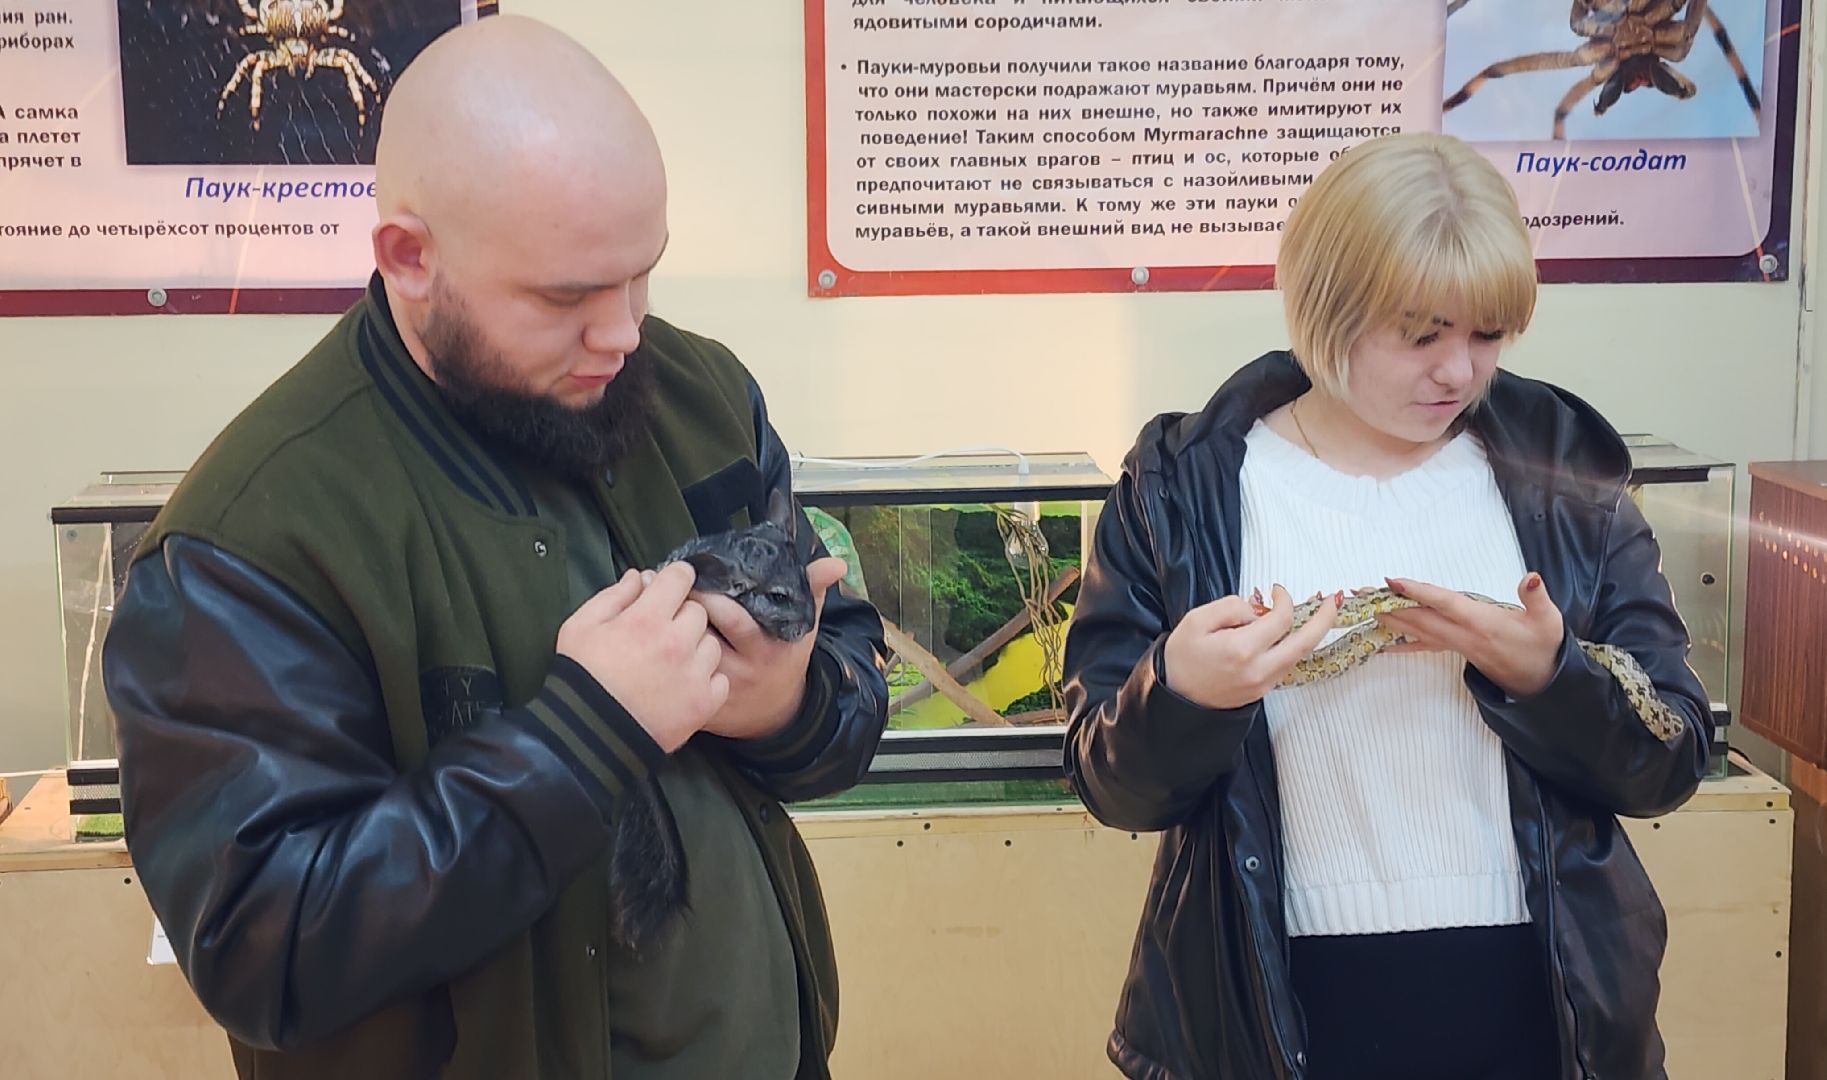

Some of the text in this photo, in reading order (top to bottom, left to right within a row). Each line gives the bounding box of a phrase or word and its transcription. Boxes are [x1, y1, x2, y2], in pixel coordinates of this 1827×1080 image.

[34, 11, 73, 29] ран.
[853, 15, 1103, 33] ядовитыми сородичами.
[857, 53, 1405, 78] Пауки-муровьи получили такое название благодаря тому,
[858, 76, 1404, 101] что они мастерски подражают муравьям. Причём они не
[14, 107, 79, 120] самка
[854, 102, 1402, 122] только похожи на них внешне, но также имитируют их
[16, 131, 81, 145] плетет
[860, 124, 1401, 148] поведение! Таким способом Myrmarachne защищаются
[70, 156, 82, 168] в
[856, 156, 877, 169] от
[884, 156, 941, 169] своих
[949, 155, 1028, 168] главных
[1036, 154, 1101, 170] врагов
[1131, 152, 1175, 167] птиц
[1183, 152, 1195, 165] и
[1204, 152, 1232, 167] ос,
[1241, 150, 1320, 166] которые
[1516, 147, 1687, 178] Паук-солдат
[856, 170, 1314, 195] предпочитают не связываться с назойливыми
[855, 202, 945, 216] сивными
[954, 201, 1067, 218] муравьями.
[1076, 197, 1089, 213] К
[1096, 199, 1142, 216] тому
[1150, 199, 1177, 212] же
[1185, 198, 1216, 211] эти
[1225, 197, 1278, 213] пауки
[67, 224, 91, 239] до
[96, 220, 210, 240] четырёхсот
[214, 223, 315, 239] процентов
[319, 223, 340, 236] от
[855, 221, 955, 242] муравьёв,
[960, 226, 972, 238] а
[975, 220, 1031, 237] такой
[1037, 218, 1125, 237] внешний
[1130, 222, 1166, 237] вид
[1170, 222, 1194, 234] не
